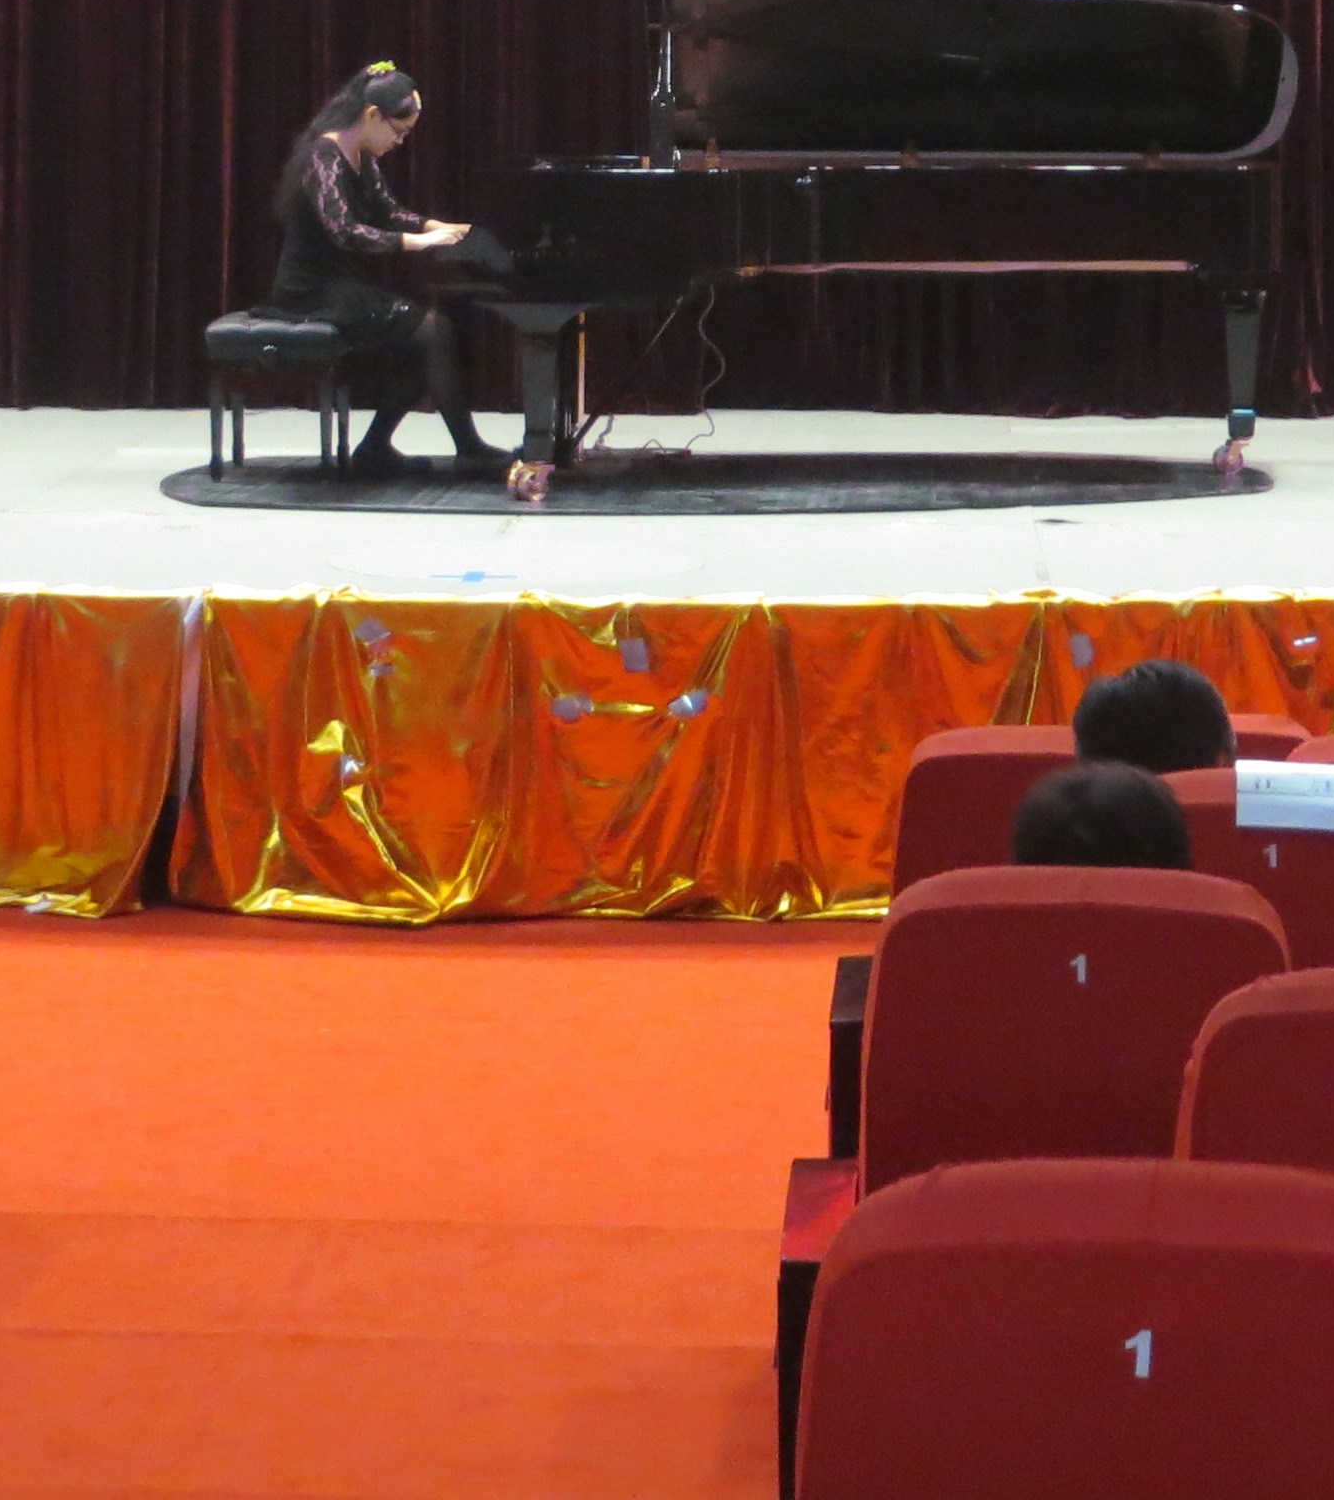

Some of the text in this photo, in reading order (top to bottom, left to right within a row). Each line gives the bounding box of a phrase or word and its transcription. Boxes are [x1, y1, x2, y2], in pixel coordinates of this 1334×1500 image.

[1263, 843, 1279, 869] 1
[1068, 952, 1087, 985] 1
[1123, 1328, 1154, 1380] 1
